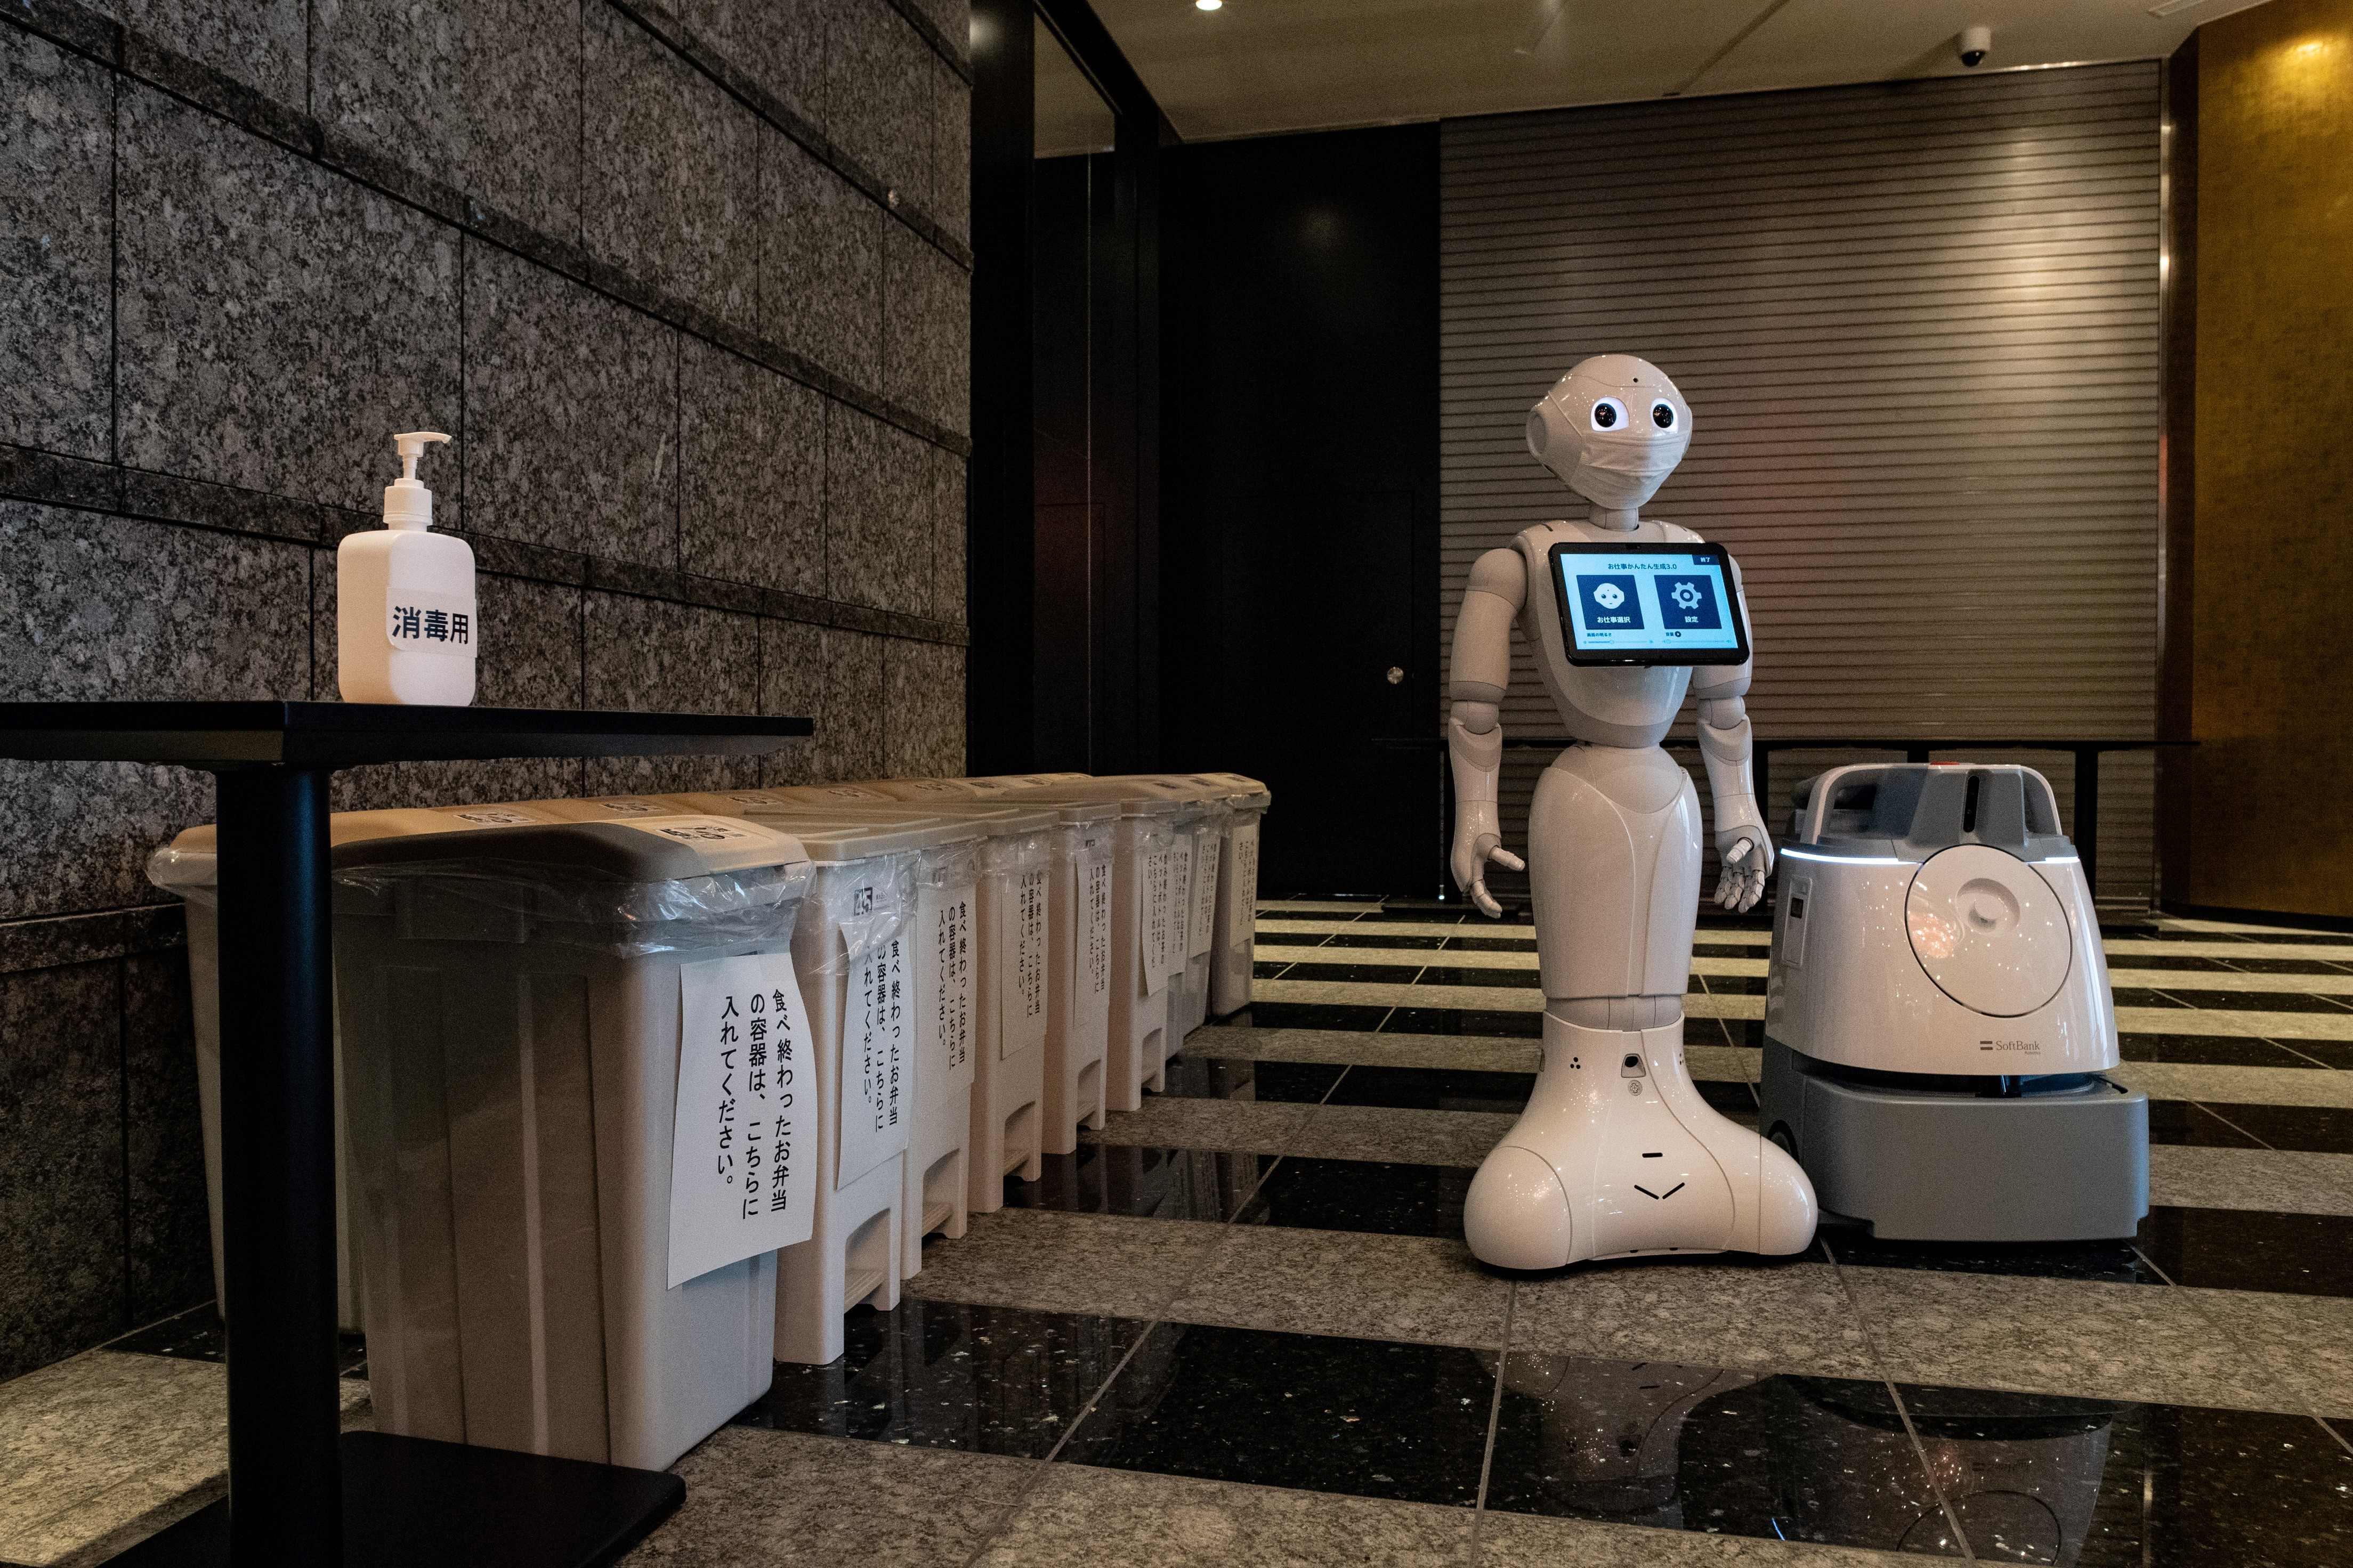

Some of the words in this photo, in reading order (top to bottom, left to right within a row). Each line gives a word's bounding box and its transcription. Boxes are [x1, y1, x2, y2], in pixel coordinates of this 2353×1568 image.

[392, 606, 469, 645] 消毒用
[717, 995, 739, 1185] 入れてください。
[743, 993, 767, 1219] の容器は、こちらに
[771, 989, 793, 1213] 食べ終わったお弁当
[890, 940, 901, 1125] 食べ終わったお弁当
[1995, 1040, 2040, 1051] SoftBank
